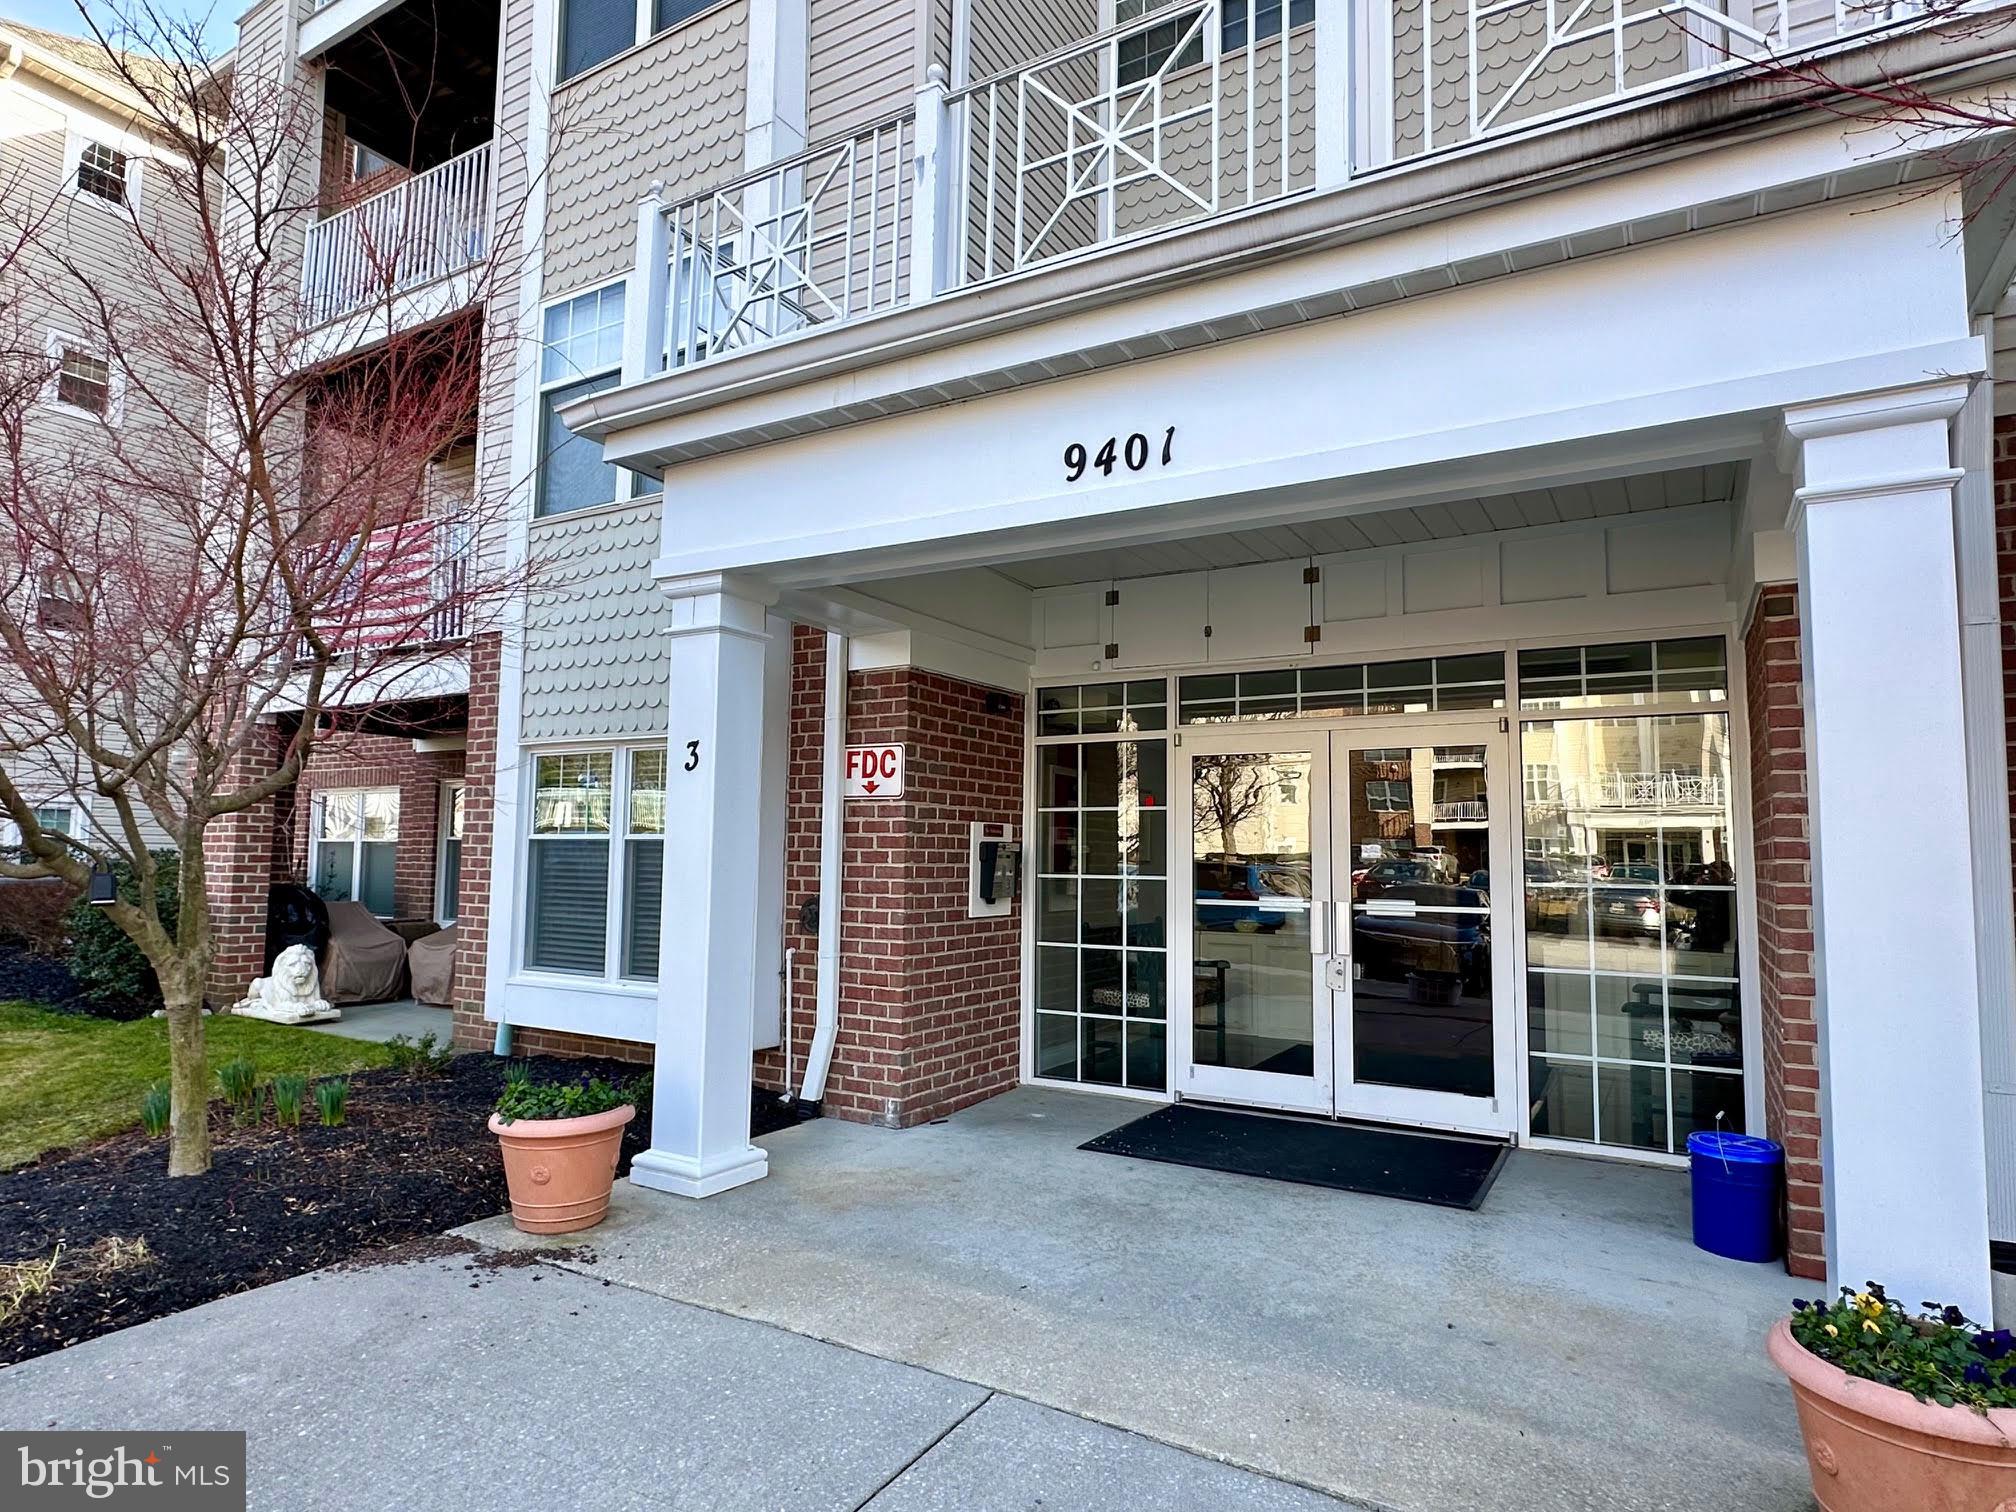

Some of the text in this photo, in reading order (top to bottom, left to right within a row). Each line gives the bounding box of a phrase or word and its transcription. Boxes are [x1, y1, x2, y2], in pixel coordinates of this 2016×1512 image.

[1064, 426, 1175, 481] 9401
[684, 740, 700, 771] 3
[846, 750, 896, 779] FDC
